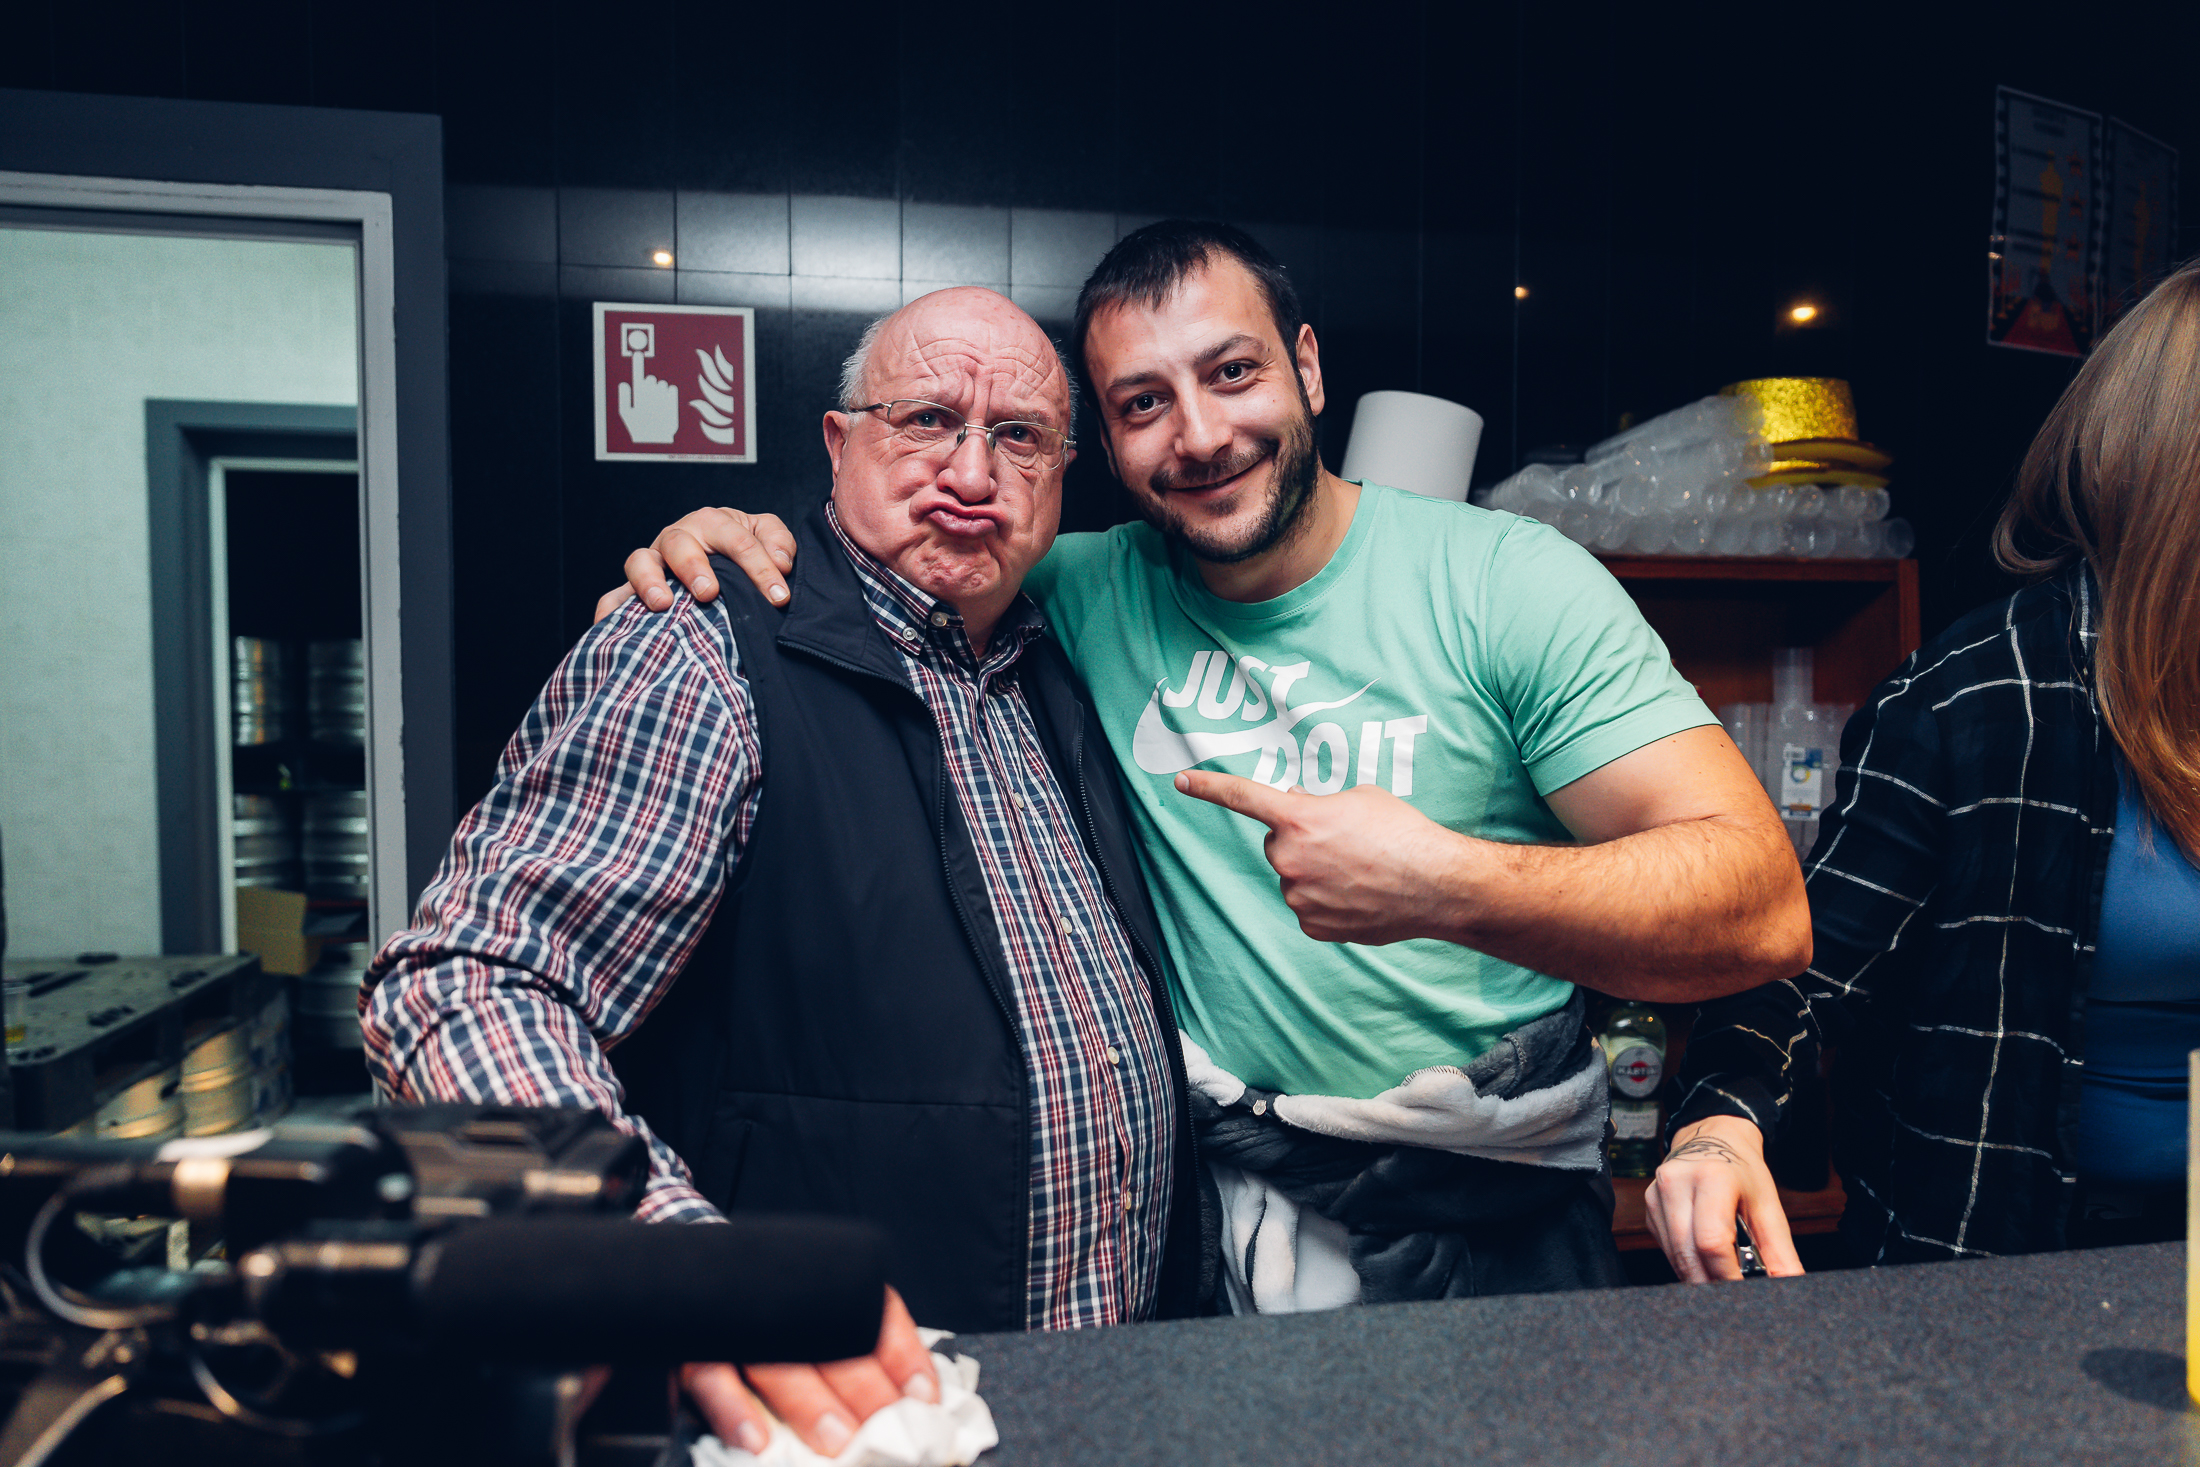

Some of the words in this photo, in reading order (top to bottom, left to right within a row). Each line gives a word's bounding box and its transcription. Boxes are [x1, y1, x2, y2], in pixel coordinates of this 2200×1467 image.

[1162, 650, 1311, 724] JUST
[1252, 721, 1350, 796] DO
[1356, 714, 1428, 797] IT
